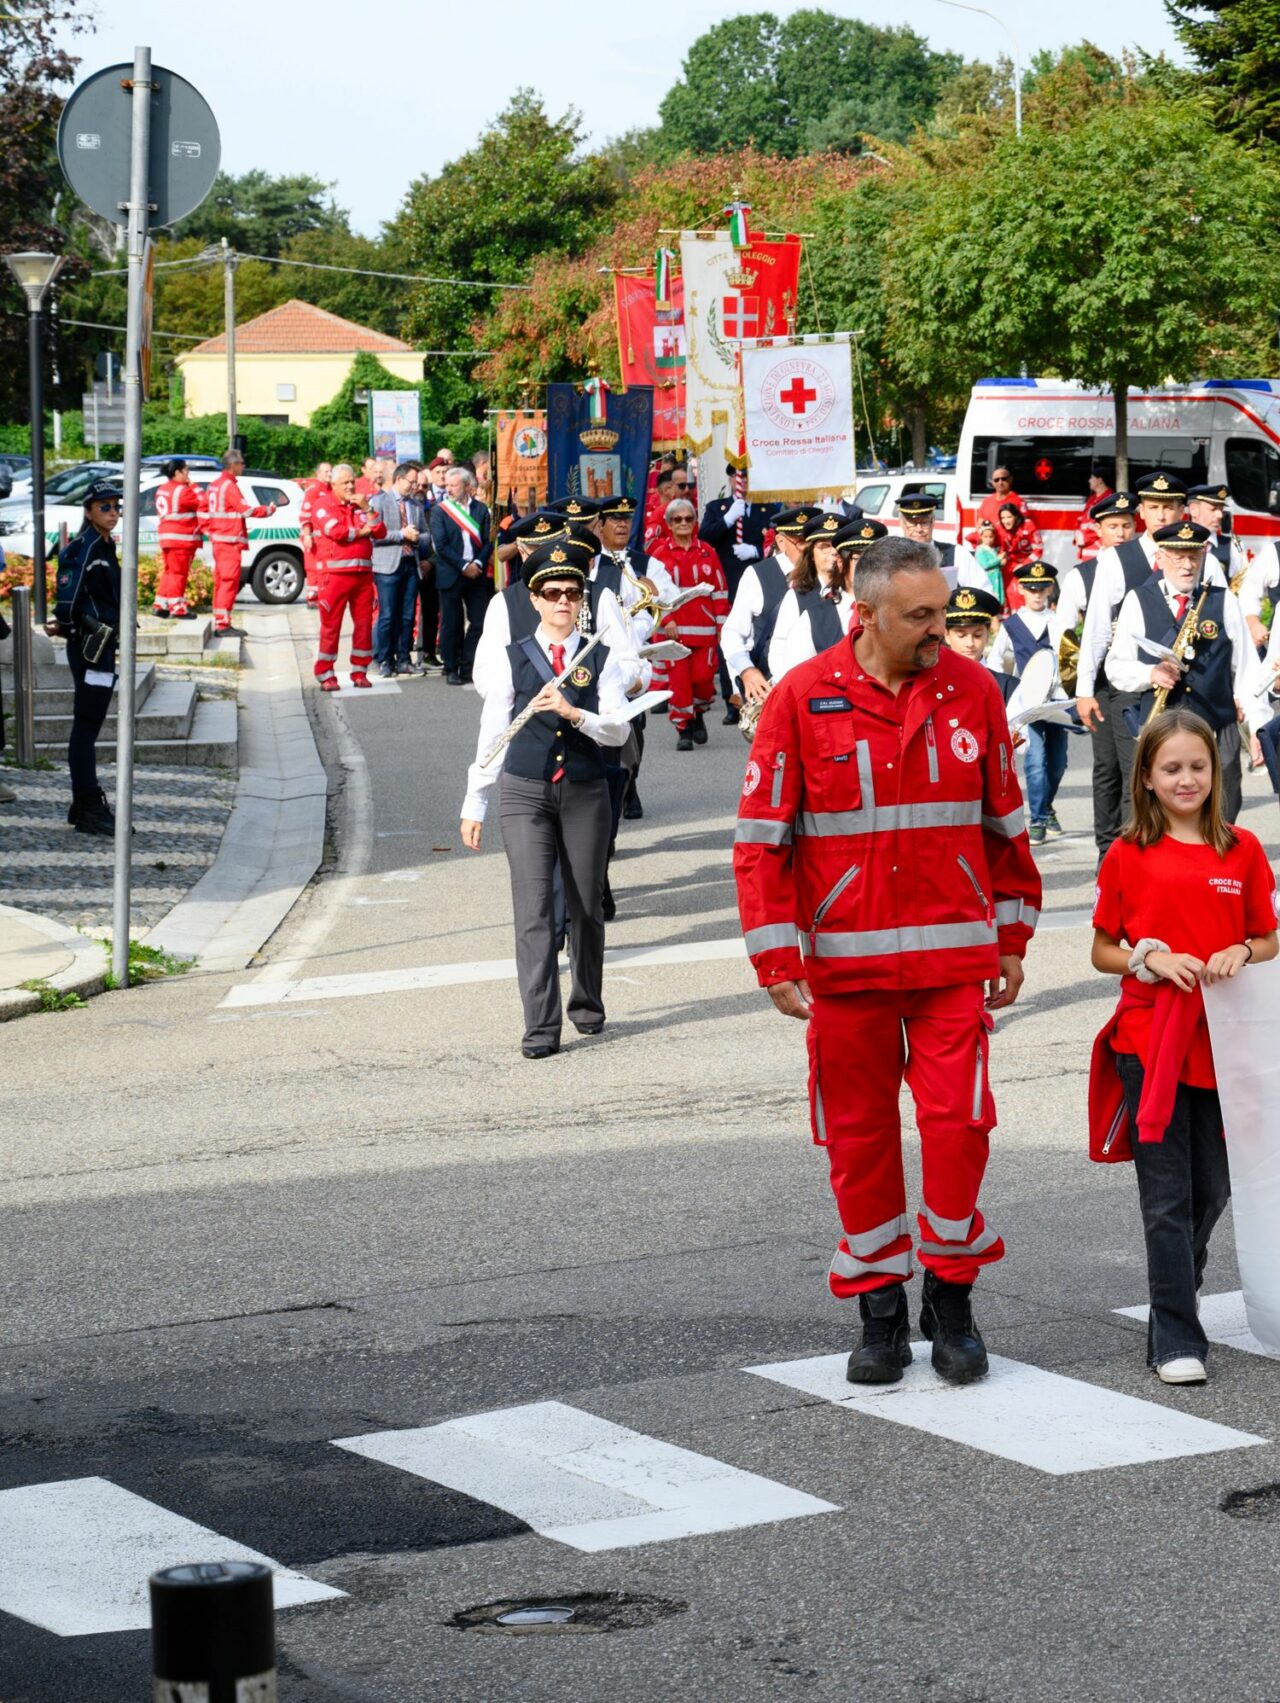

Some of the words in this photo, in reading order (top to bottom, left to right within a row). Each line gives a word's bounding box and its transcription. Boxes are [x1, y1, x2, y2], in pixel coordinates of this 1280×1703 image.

[742, 250, 776, 266] OLEGGIO
[1018, 416, 1066, 429] CROCE
[1068, 416, 1114, 429] ROSSA
[1127, 416, 1181, 429] ALIANA
[752, 438, 780, 447] Croce
[783, 437, 812, 446] Rossa
[815, 433, 847, 443] Italiana
[1209, 878, 1232, 886] CROCE
